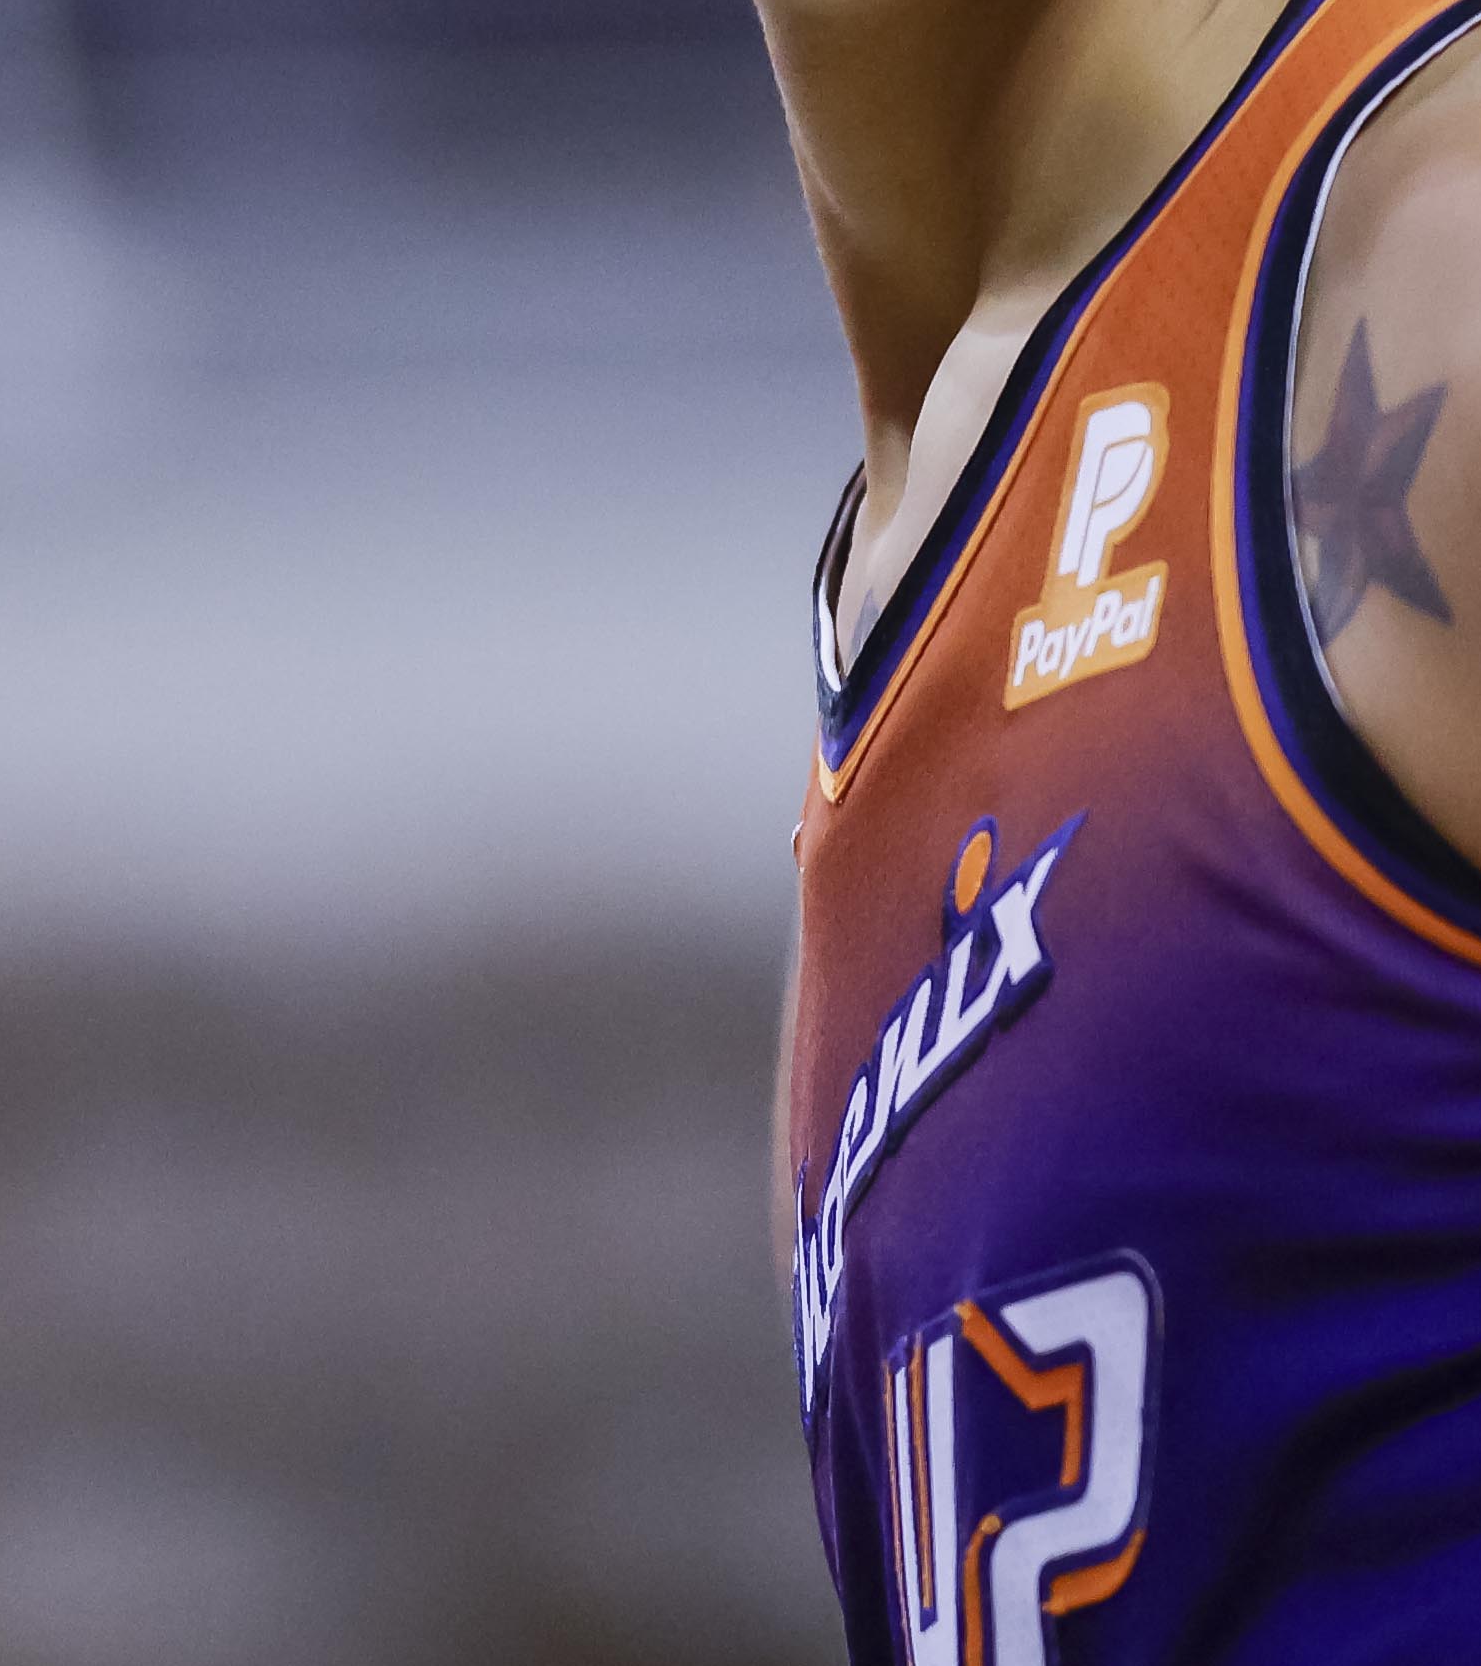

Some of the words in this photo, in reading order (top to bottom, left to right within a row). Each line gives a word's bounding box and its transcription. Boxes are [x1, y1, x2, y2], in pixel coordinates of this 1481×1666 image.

[1012, 575, 1161, 687] PayPal
[793, 828, 1062, 1413] hoenix
[883, 1269, 1159, 1666] 42
